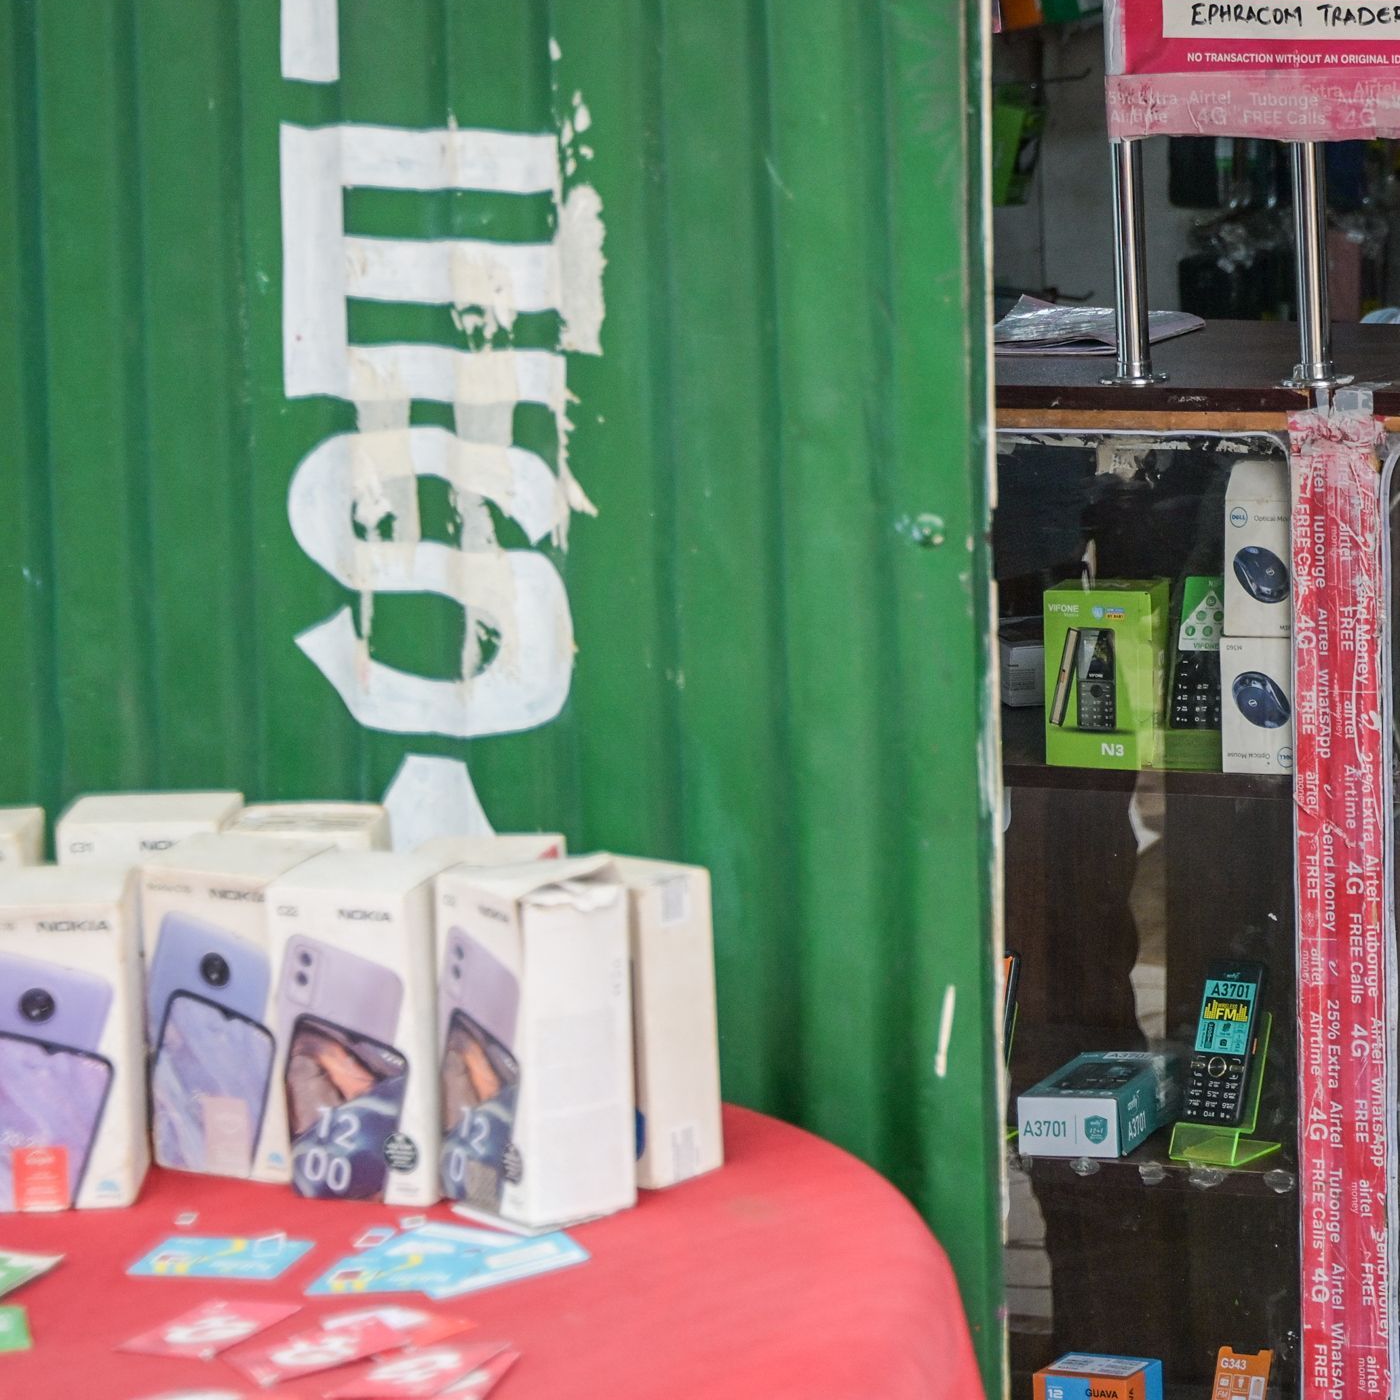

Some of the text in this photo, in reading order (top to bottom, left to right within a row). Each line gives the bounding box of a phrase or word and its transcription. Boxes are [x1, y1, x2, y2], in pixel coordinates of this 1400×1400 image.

[1191, 2, 1303, 26] EPHRACOM
[1187, 52, 1203, 62] NO
[1205, 52, 1273, 63] TRANSACTION
[1275, 52, 1323, 64] WITHOUT
[1323, 53, 1338, 64] AN
[1341, 53, 1390, 64] ORIGINAL
[1243, 110, 1326, 126] FREE Calls
[1250, 91, 1318, 109] Tubonge
[1048, 603, 1080, 613] VIFONE
[1340, 606, 1353, 651] FREE
[1100, 743, 1125, 757] N3
[1343, 764, 1358, 829] Airtime
[1362, 799, 1376, 842] Extra
[1306, 854, 1320, 899] FREE
[1321, 822, 1337, 932] Send Money
[1345, 860, 1363, 895] 4G
[1364, 854, 1380, 902] Airtel
[36, 919, 111, 933] NOKIA
[337, 908, 393, 923] NOKIA
[1309, 948, 1325, 987] airtel
[1349, 912, 1364, 1004] FREE Calls
[1364, 922, 1381, 997] Tubonge
[1211, 982, 1250, 998] A3701
[1216, 1008, 1238, 1021] FM
[1309, 1010, 1324, 1076] Airtime
[1327, 999, 1342, 1089] 25% Extra
[1351, 1023, 1369, 1144] 4G FREE
[1369, 1016, 1386, 1168] Airtel WhatsApp
[315, 1107, 360, 1150] 12
[459, 1106, 489, 1150] 12
[1023, 1120, 1067, 1137] A3701
[1127, 1111, 1147, 1141] A3701
[1309, 1105, 1329, 1142] 4G
[1329, 1100, 1344, 1148] Airtel
[302, 1153, 352, 1193] 00
[1311, 1158, 1326, 1249] FREE Calls
[1326, 1168, 1343, 1243] Tubonge
[1359, 1179, 1373, 1217] airtel
[1331, 1262, 1345, 1310] Airtel
[1360, 1262, 1374, 1306] FREE
[1310, 1267, 1330, 1388] 4G FREE
[1220, 1357, 1247, 1370] G343
[1366, 1355, 1380, 1395] airtel
[1085, 1388, 1119, 1398] GUAVA
